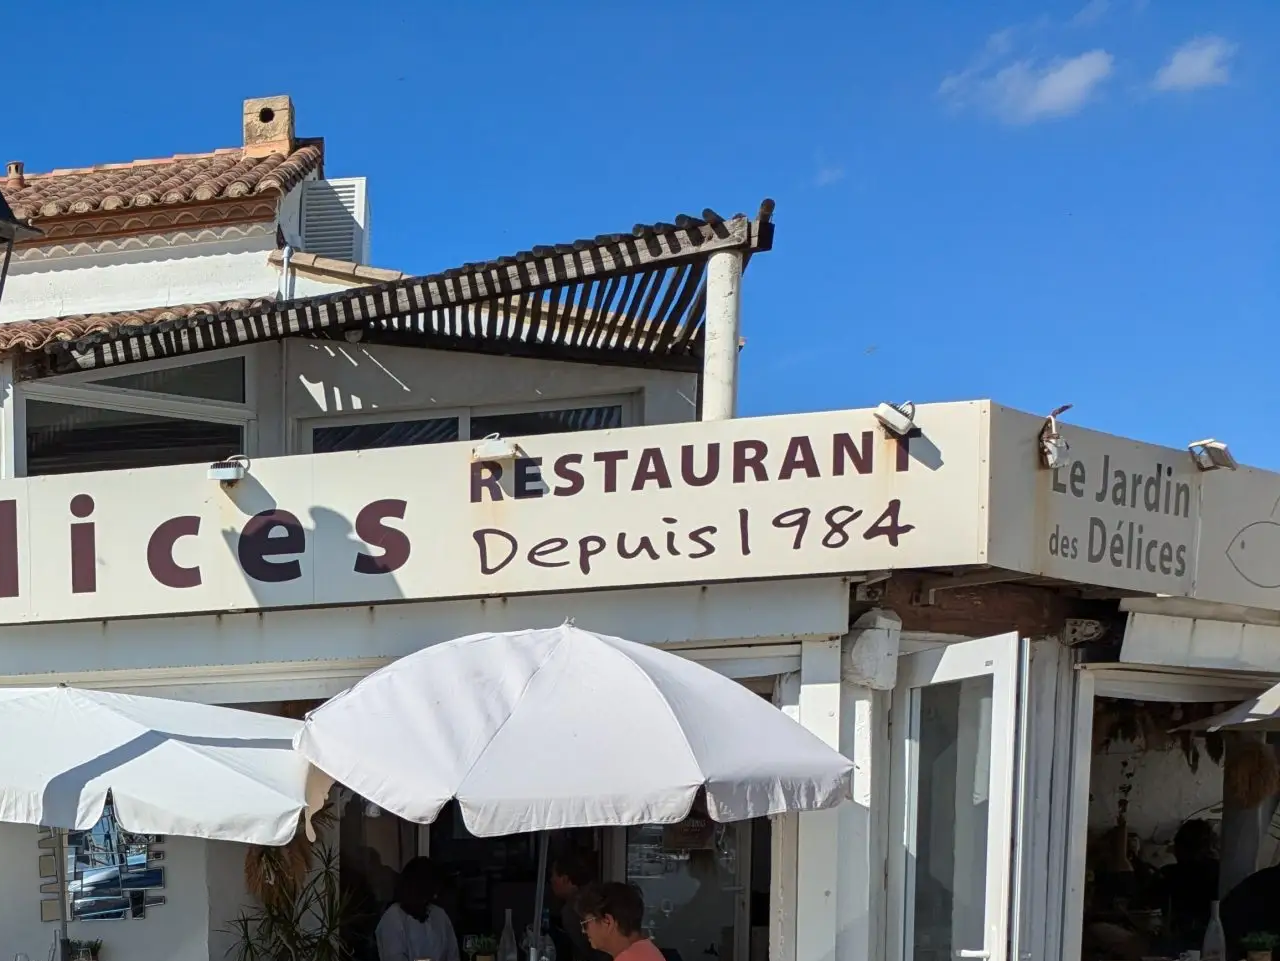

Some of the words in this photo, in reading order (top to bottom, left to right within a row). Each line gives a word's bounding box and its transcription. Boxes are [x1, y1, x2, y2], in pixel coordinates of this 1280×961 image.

[469, 426, 922, 504] RESTAURANT
[1051, 457, 1086, 498] Le
[1095, 454, 1191, 519] Jardin
[472, 516, 718, 576] Depuis
[738, 498, 916, 556] 1984
[1048, 524, 1078, 560] des
[1087, 516, 1187, 578] Délices
